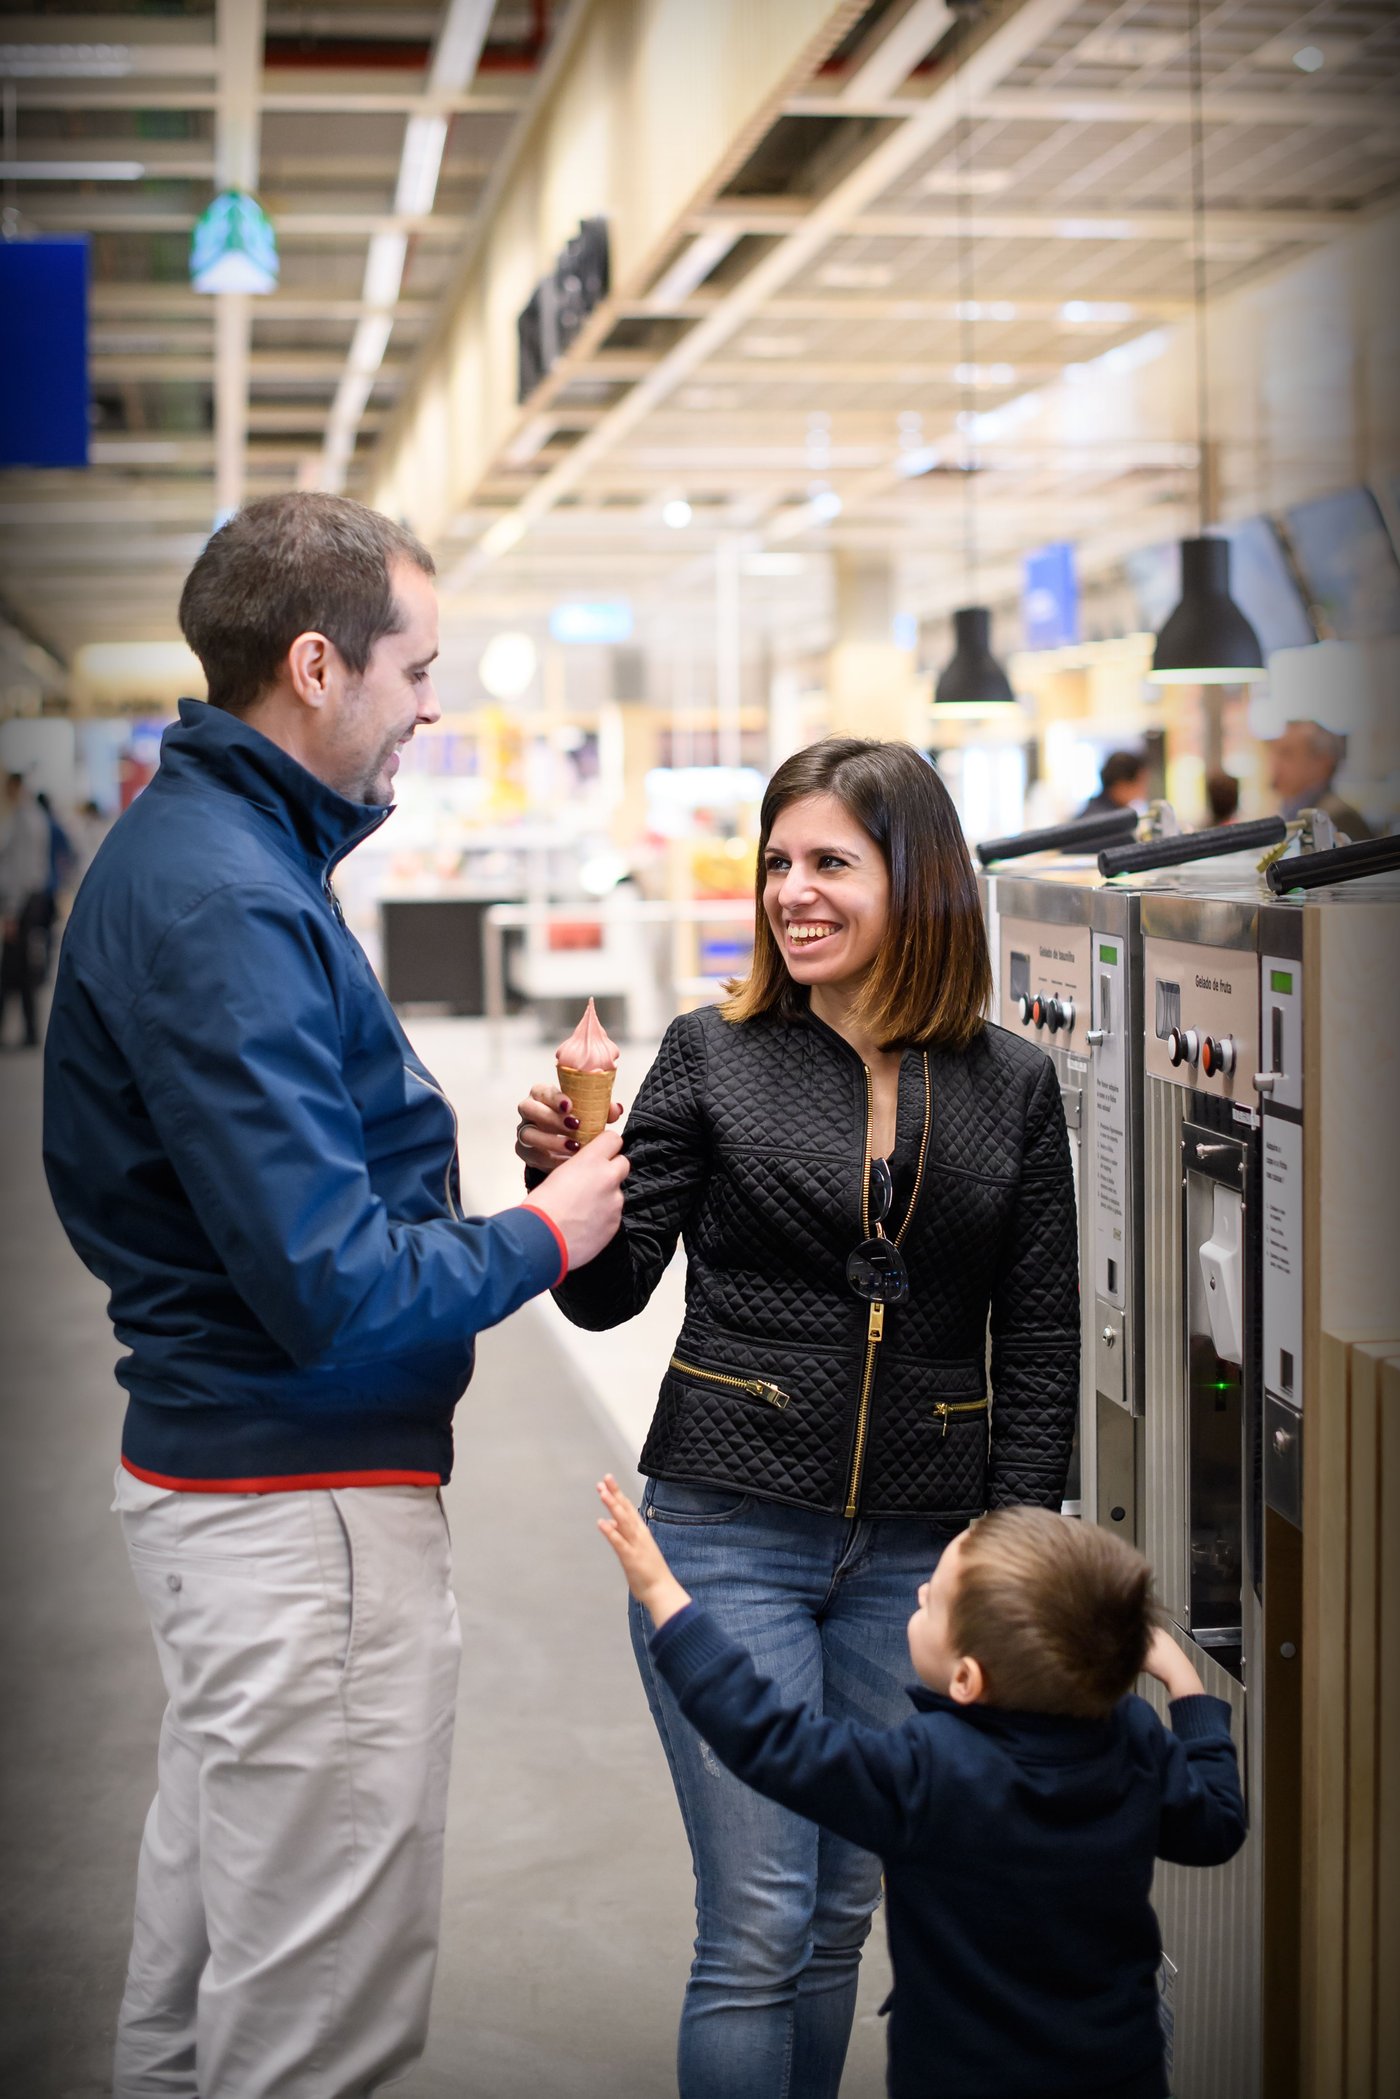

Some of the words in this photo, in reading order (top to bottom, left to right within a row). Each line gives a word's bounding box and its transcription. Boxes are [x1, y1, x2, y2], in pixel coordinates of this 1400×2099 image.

[1195, 974, 1211, 990] Gelado
[1213, 978, 1218, 991] de
[1220, 979, 1231, 994] fruta
